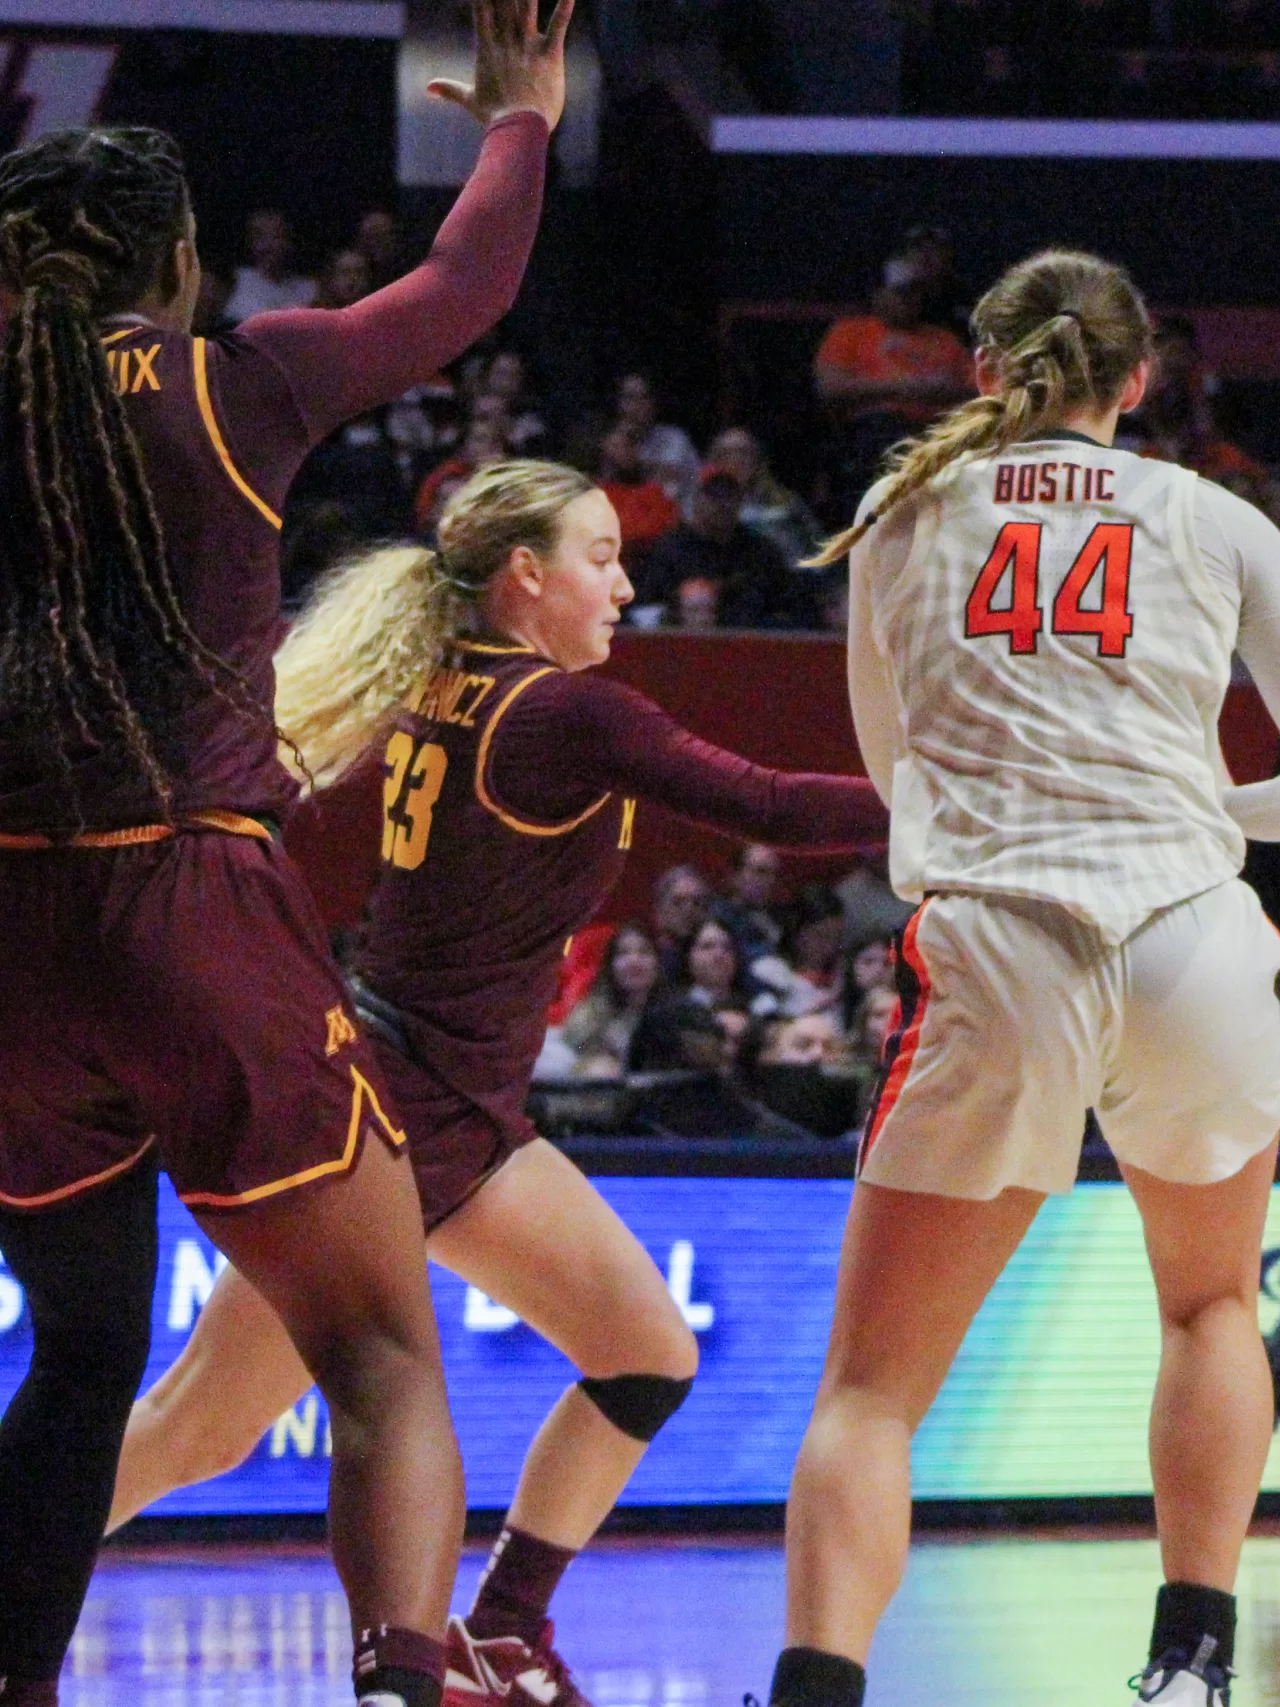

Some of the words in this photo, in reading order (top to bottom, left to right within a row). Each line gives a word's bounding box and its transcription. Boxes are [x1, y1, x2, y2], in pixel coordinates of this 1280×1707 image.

[993, 462, 1115, 504] BOSTIC
[964, 521, 1136, 658] 44
[381, 731, 449, 871] 23
